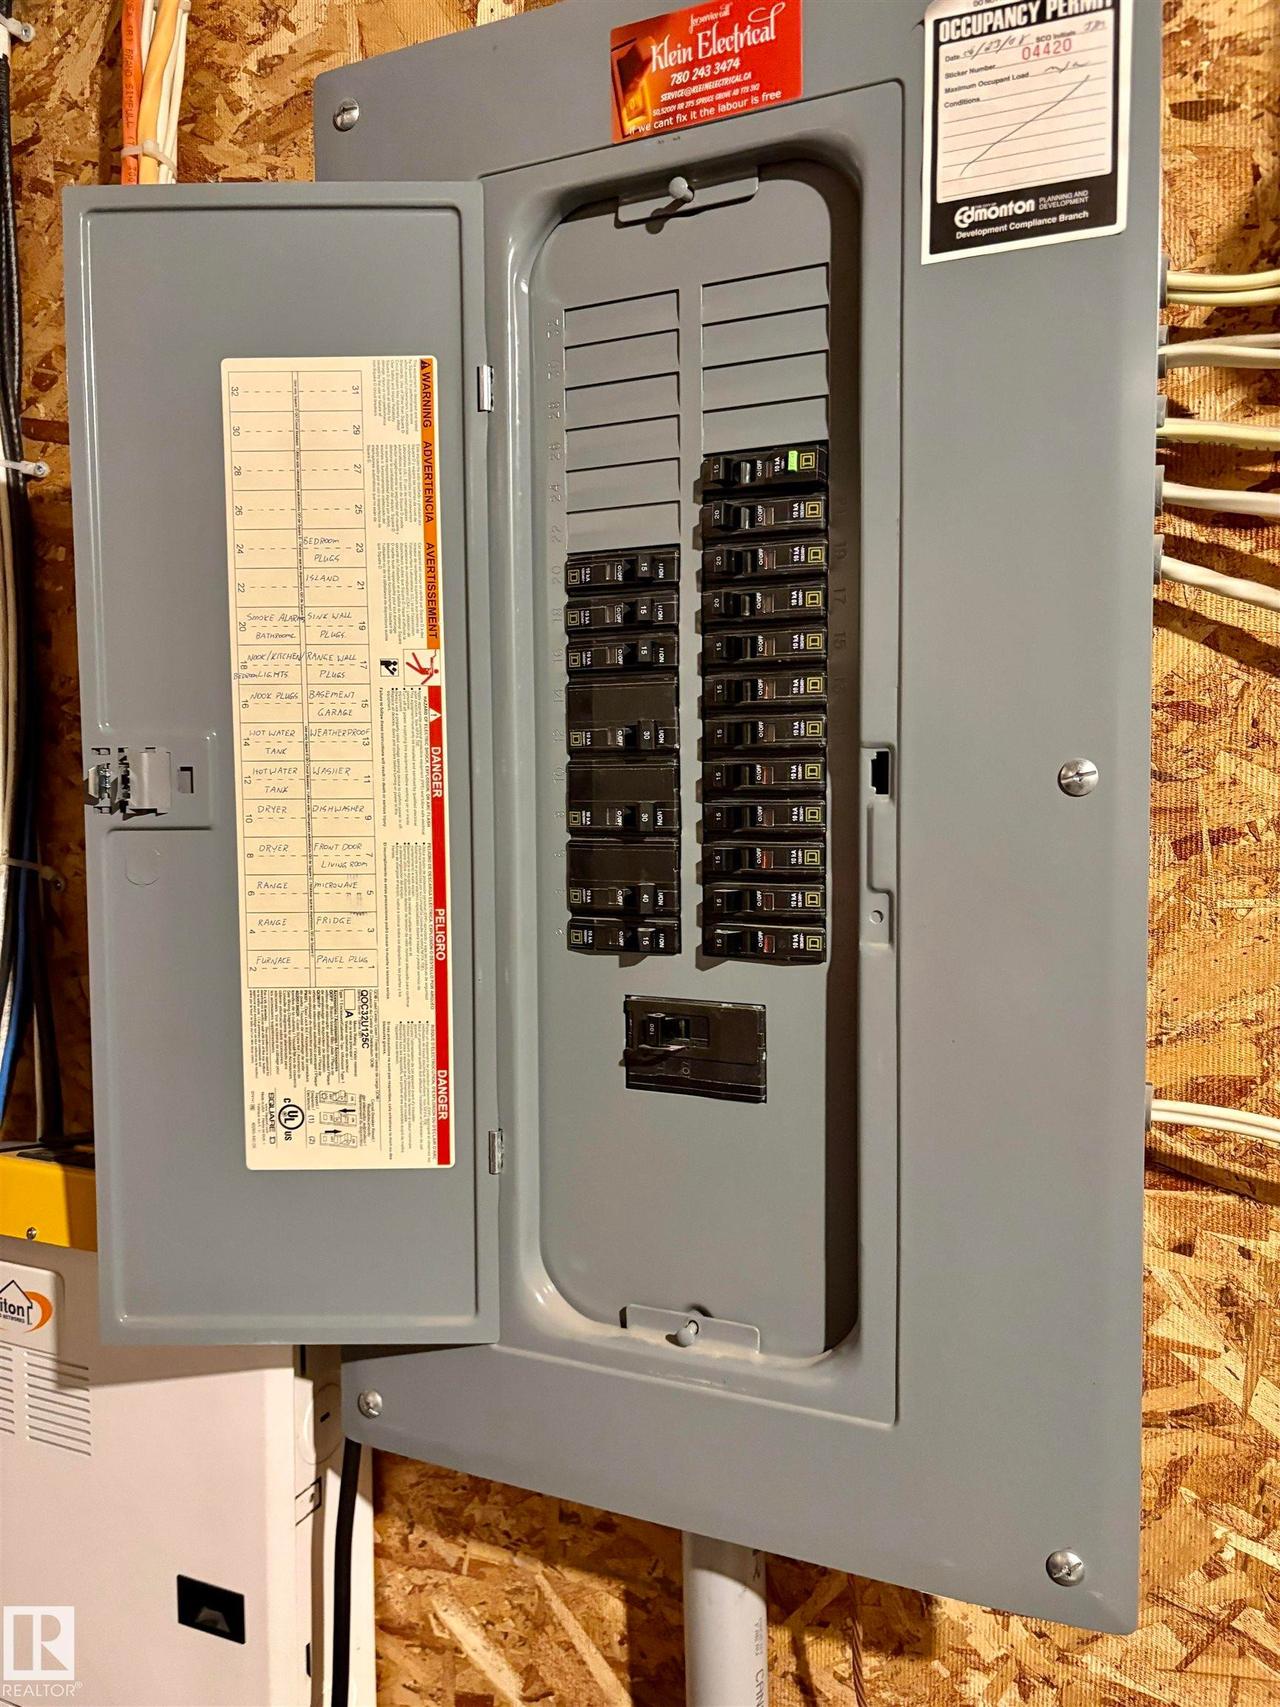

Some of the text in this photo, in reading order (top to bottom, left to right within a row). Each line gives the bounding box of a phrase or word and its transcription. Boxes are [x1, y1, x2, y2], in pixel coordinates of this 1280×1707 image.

[938, 1, 1040, 43] OCCUPANCY
[651, 2, 786, 73] Klein Electrical
[1022, 38, 1072, 60] 04420
[945, 54, 960, 62] Date
[670, 57, 742, 87] 780 243 3474
[944, 64, 996, 80] Sticker Number
[944, 72, 1030, 94] Maximum Occupant Load
[944, 96, 980, 109] Conditions
[638, 122, 651, 132] we
[654, 118, 674, 130] cant
[676, 112, 688, 123] fix
[690, 109, 697, 120] it
[700, 106, 715, 118] the
[718, 98, 748, 114] labour
[751, 95, 760, 105] is
[762, 90, 782, 102] free
[1038, 190, 1088, 204] PLANNING AND
[1038, 196, 1089, 210] DEVELOPMENT
[954, 198, 1035, 229] Edmonton
[956, 210, 1089, 240] Development Compliance Branch
[231, 386, 239, 396] 32
[352, 386, 360, 395] 31
[420, 372, 432, 428] WARNING
[232, 426, 240, 436] 30
[353, 424, 360, 436] 29
[234, 466, 242, 476] 28
[354, 464, 362, 474] 27
[423, 441, 434, 523] ADVERTENCIA
[234, 506, 243, 516] 26
[354, 504, 362, 514] 25
[304, 537, 340, 546] BEDROOM
[236, 544, 244, 554] 24
[356, 543, 364, 553] 23
[314, 554, 340, 562] PLUGS
[306, 574, 340, 582] ISLAND
[237, 582, 245, 592] 22
[357, 581, 364, 590] 21
[426, 542, 438, 638] AVERTISSEMENT
[246, 613, 274, 622] SMOKE
[308, 612, 352, 620] SINK WALL
[238, 622, 246, 632] 20
[358, 621, 366, 630] 19
[320, 630, 345, 640] PLUGS
[306, 652, 357, 662] RANGE WALL
[240, 661, 248, 670] 18
[360, 660, 367, 670] 17
[320, 670, 346, 678] PLUGS
[309, 690, 355, 699] BASEMENT
[242, 700, 249, 708] 16
[361, 699, 368, 708] 15
[318, 708, 353, 716] GARAGE
[310, 728, 370, 737] WEATHERPROOF
[243, 738, 250, 746] 14
[362, 737, 370, 746] 13
[312, 767, 351, 776] WASHER
[432, 747, 442, 798] DANGER
[244, 776, 252, 784] 12
[364, 775, 370, 784] 11
[264, 786, 288, 794] TANK
[258, 806, 288, 814] DRYER
[312, 804, 364, 812] DISHWASHER
[246, 814, 253, 824] 10
[257, 882, 288, 890] RANGE
[316, 916, 352, 925] FRIDGE
[435, 908, 446, 960] PELIGRO
[256, 956, 292, 964] FURNACE
[317, 955, 368, 963] PANEL PLUG
[345, 1010, 354, 1018] A
[360, 990, 370, 1048] QOC32U125C
[438, 1070, 448, 1120] DANGER
[284, 1131, 292, 1141] US
